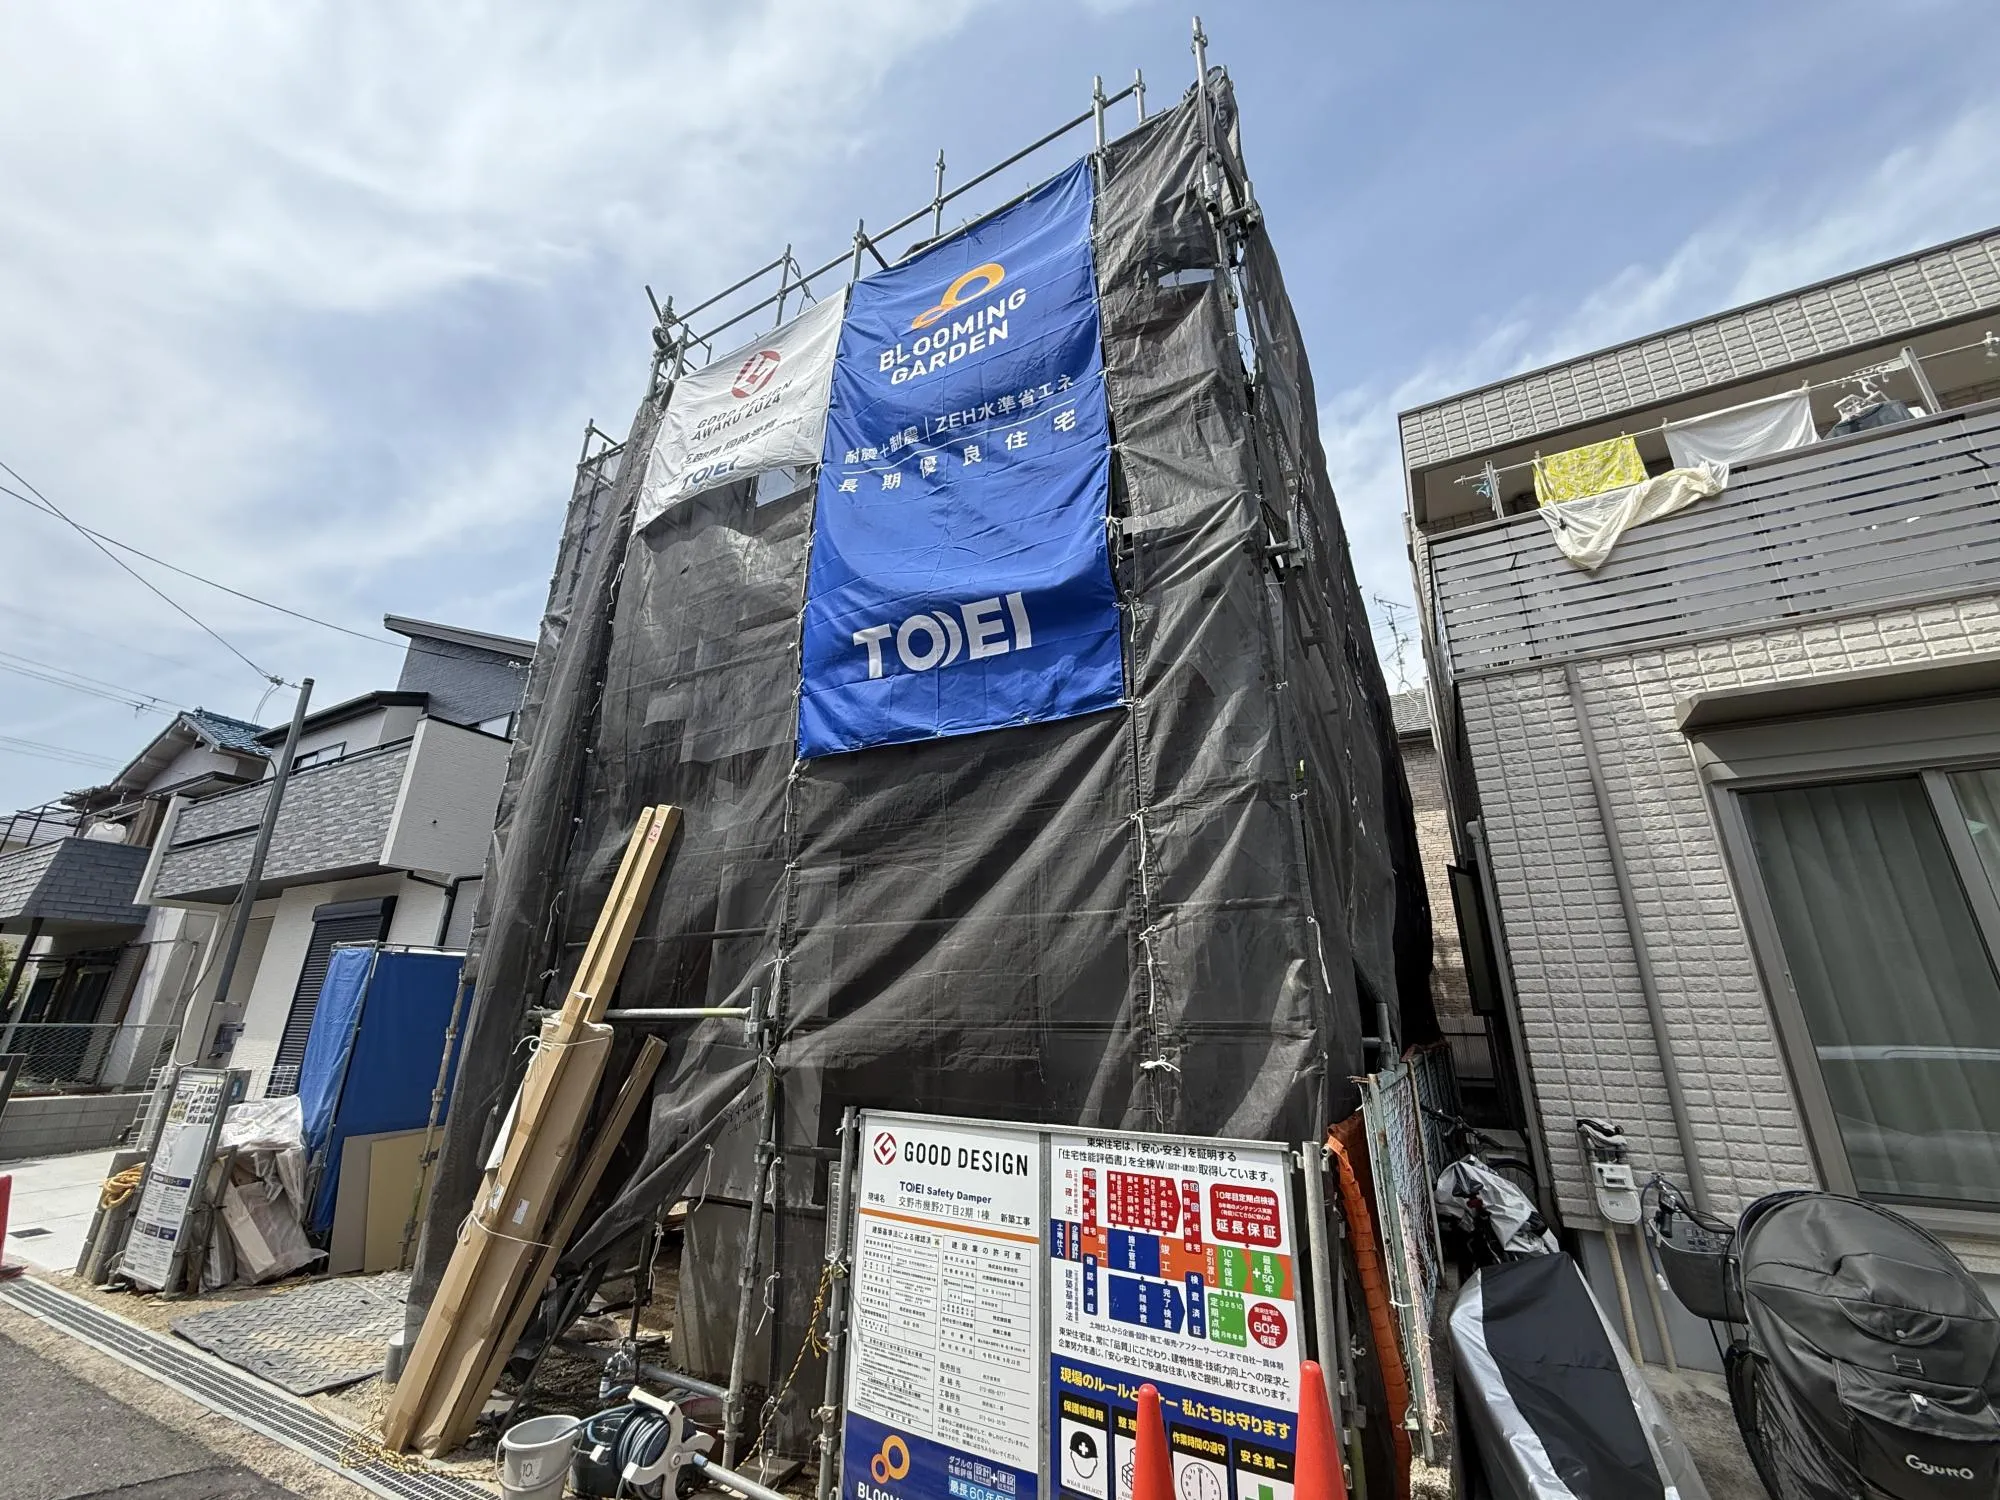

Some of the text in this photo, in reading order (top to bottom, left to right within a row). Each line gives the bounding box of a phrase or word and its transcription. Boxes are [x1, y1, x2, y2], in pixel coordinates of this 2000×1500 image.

[879, 288, 1027, 372] BLOOMING
[890, 319, 1009, 385] GARDEN
[691, 393, 781, 441] AWARD 2024
[696, 380, 793, 429] GOOD DESIGN
[935, 373, 1075, 434] ZEH水準省エネ
[838, 408, 1077, 493] 長期優良住宅
[682, 456, 739, 490] TOEI
[852, 591, 1032, 680] TOEI
[904, 1141, 1029, 1177] GOOD DESIGN
[1087, 1137, 1237, 1161] 東栄住宅は、「安心・安全」を証明する
[868, 1192, 886, 1203] 現場名
[900, 1181, 992, 1205] TOEI Safety Damper
[1065, 1169, 1073, 1215] 品確法
[1000, 1213, 1031, 1227] 新築工事
[1216, 1218, 1277, 1239] 延長保証
[1056, 1223, 1064, 1256] 土地仕入
[1128, 1235, 1136, 1270] 施工管理
[1206, 1248, 1215, 1284] お引渡し
[1223, 1249, 1233, 1287] 10年保証
[1065, 1269, 1073, 1321] 建築基準法
[1139, 1284, 1147, 1324] 中間検査
[1163, 1288, 1172, 1329] 完了検査
[1190, 1275, 1201, 1335] 検査済証
[1210, 1297, 1220, 1339] 定期点検
[1253, 1322, 1281, 1336] 60年
[1260, 1335, 1277, 1347] 保証
[940, 1375, 961, 1388] 連絡先
[940, 1389, 960, 1402] 工事担当
[939, 1402, 960, 1416] 連絡先
[1060, 1366, 1291, 1440] 現場のルールとー 私たちは守ります
[1063, 1400, 1104, 1422] 保護帽着用
[1172, 1431, 1226, 1457] 作業時間の遵守
[1240, 1449, 1288, 1469] 安全第一
[949, 1455, 973, 1470] ダブルの
